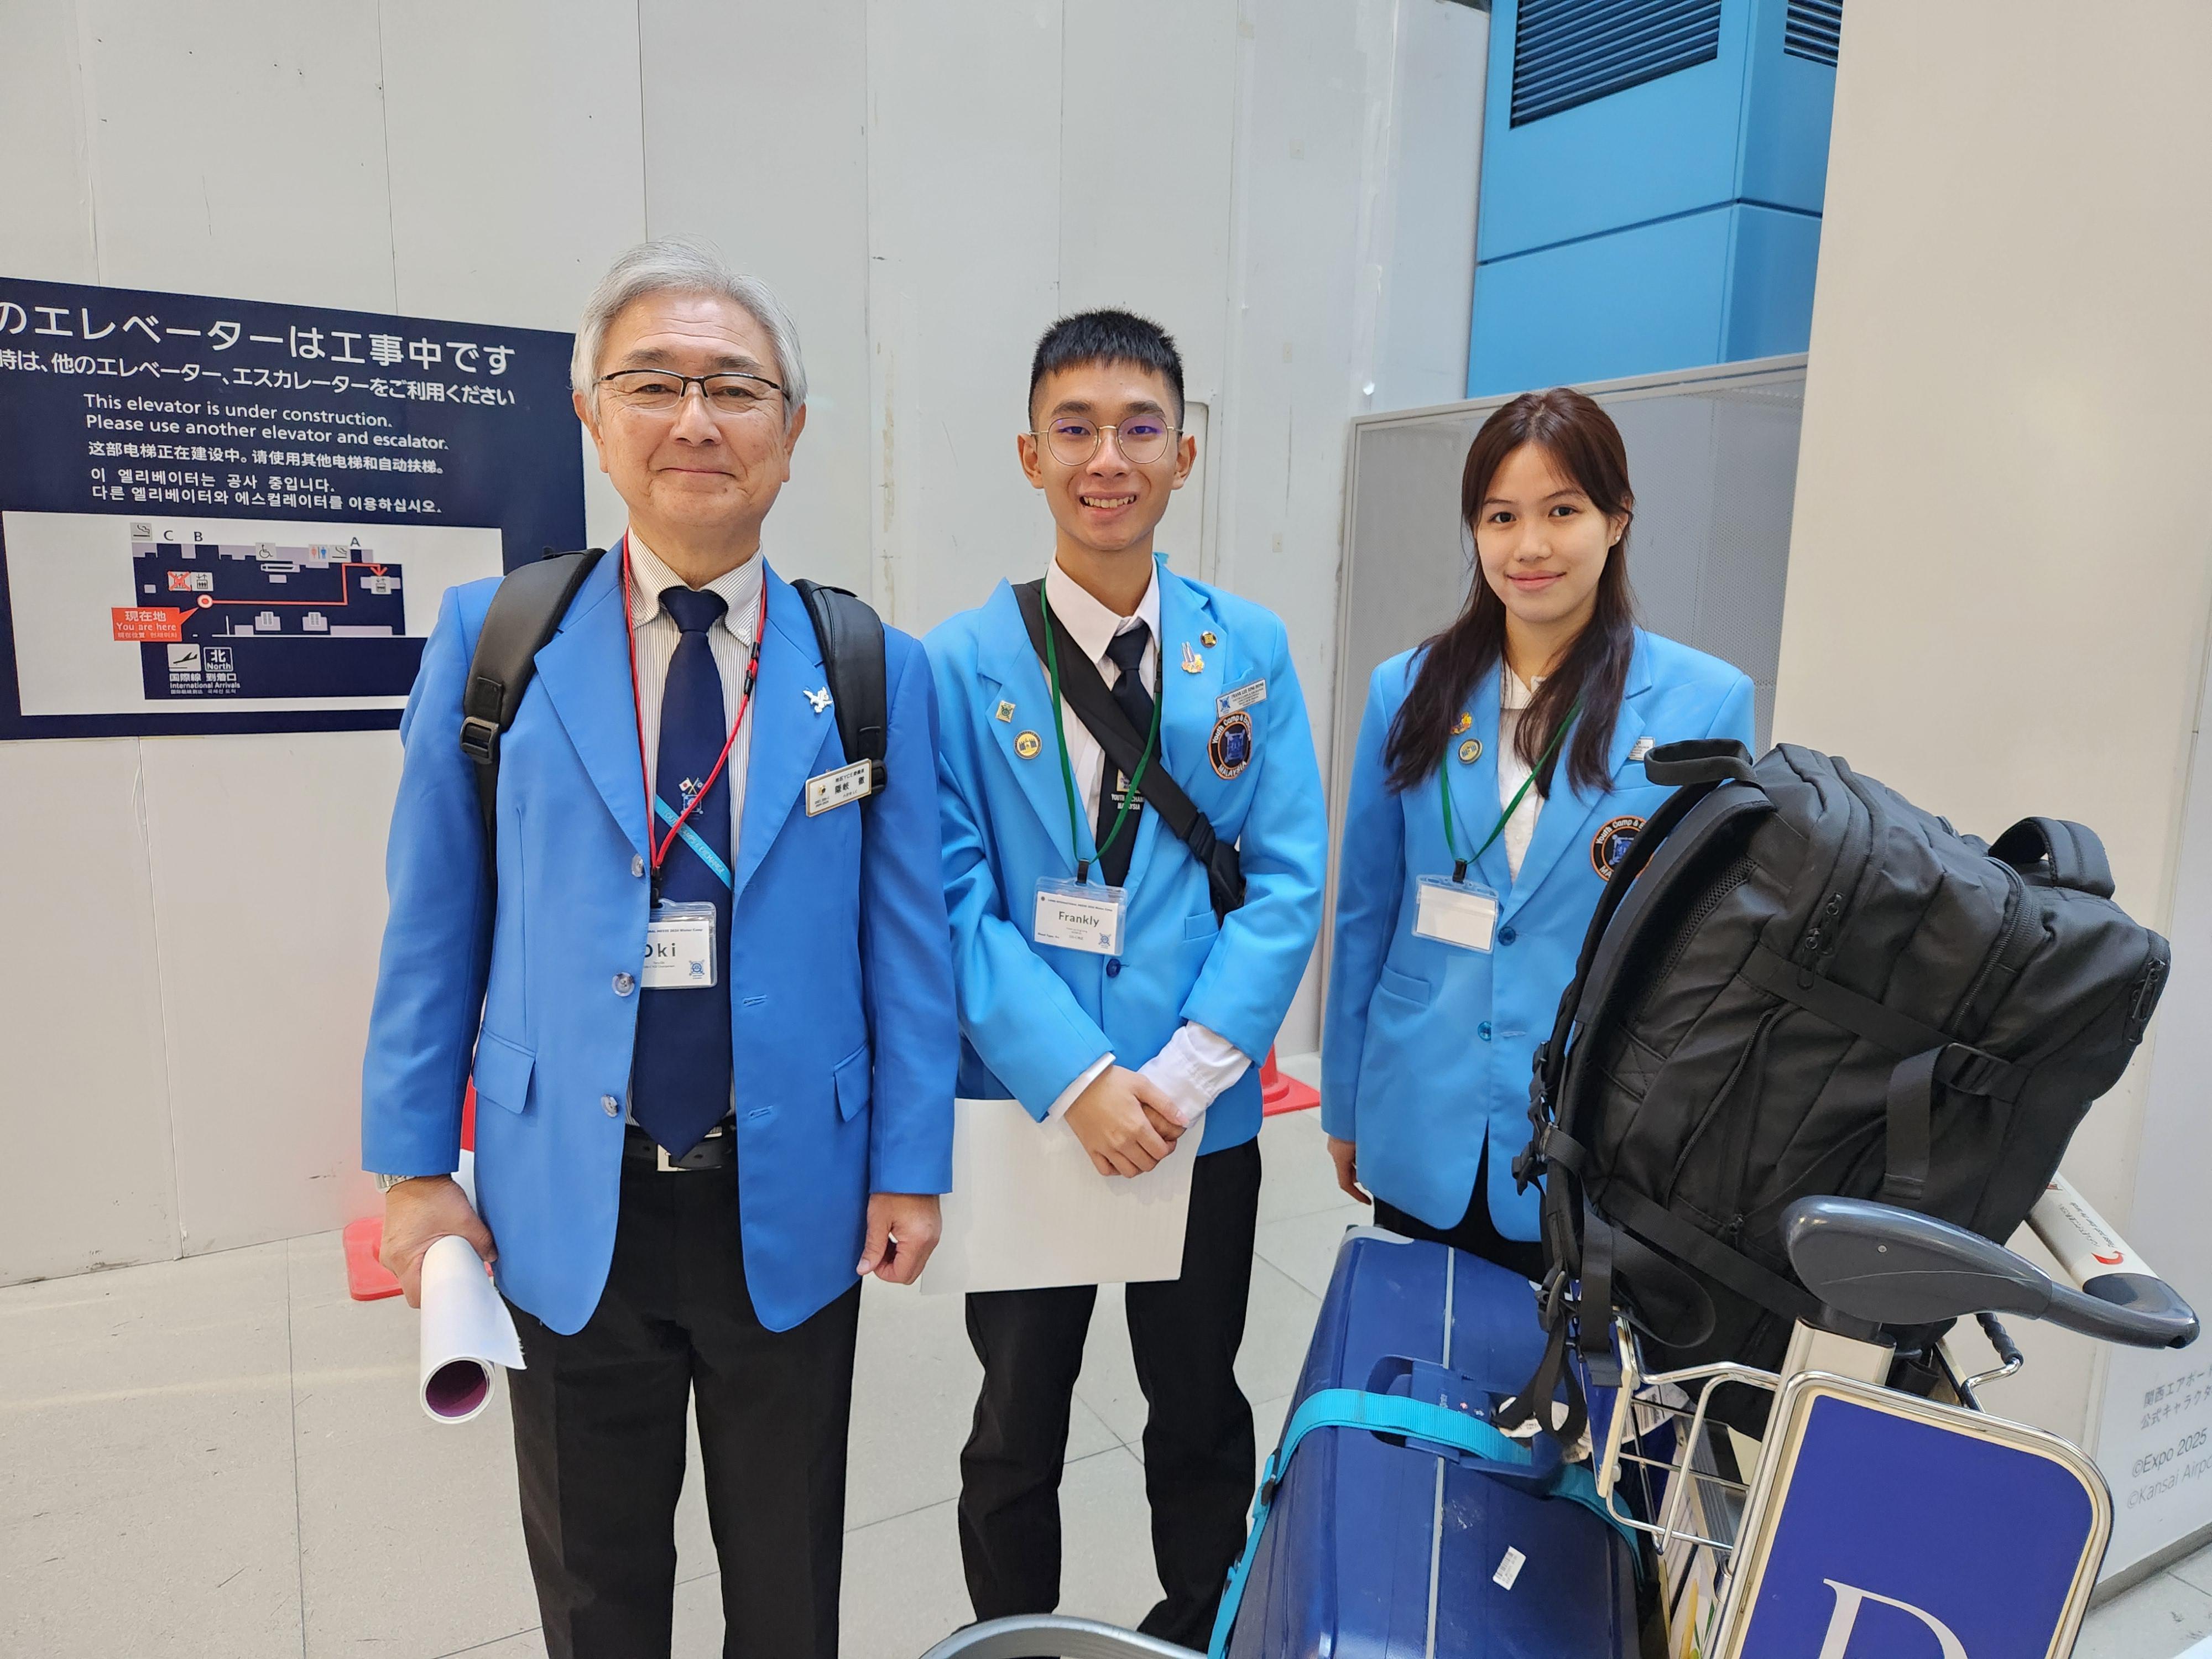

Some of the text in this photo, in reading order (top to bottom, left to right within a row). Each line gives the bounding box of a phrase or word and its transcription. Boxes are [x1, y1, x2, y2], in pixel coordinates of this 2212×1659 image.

[0, 301, 515, 375] のエレベーターは工事中です
[84, 393, 393, 428] This elevator is under construction.
[86, 415, 450, 450] Please use another elevator and escalator.
[91, 468, 335, 492] 이 엘리베이터는 공사 중입니다.
[92, 485, 442, 513] 다른 엘리베이터와 에스컬레이터를 이용하십시오.
[164, 530, 174, 541] C
[194, 531, 203, 542] B
[350, 537, 361, 547] A
[125, 610, 166, 622] 現在地
[116, 623, 134, 631] You
[156, 623, 176, 631] here
[211, 649, 226, 663] 北
[1212, 725, 1224, 744] Youth
[1223, 715, 1239, 726] Camp
[1218, 761, 1247, 776] MALAYSIA
[1595, 826, 1613, 844] Youth
[1612, 819, 1632, 828] Camp
[1058, 911, 1099, 927] Frankly
[2177, 1427, 2208, 1457] 2025
